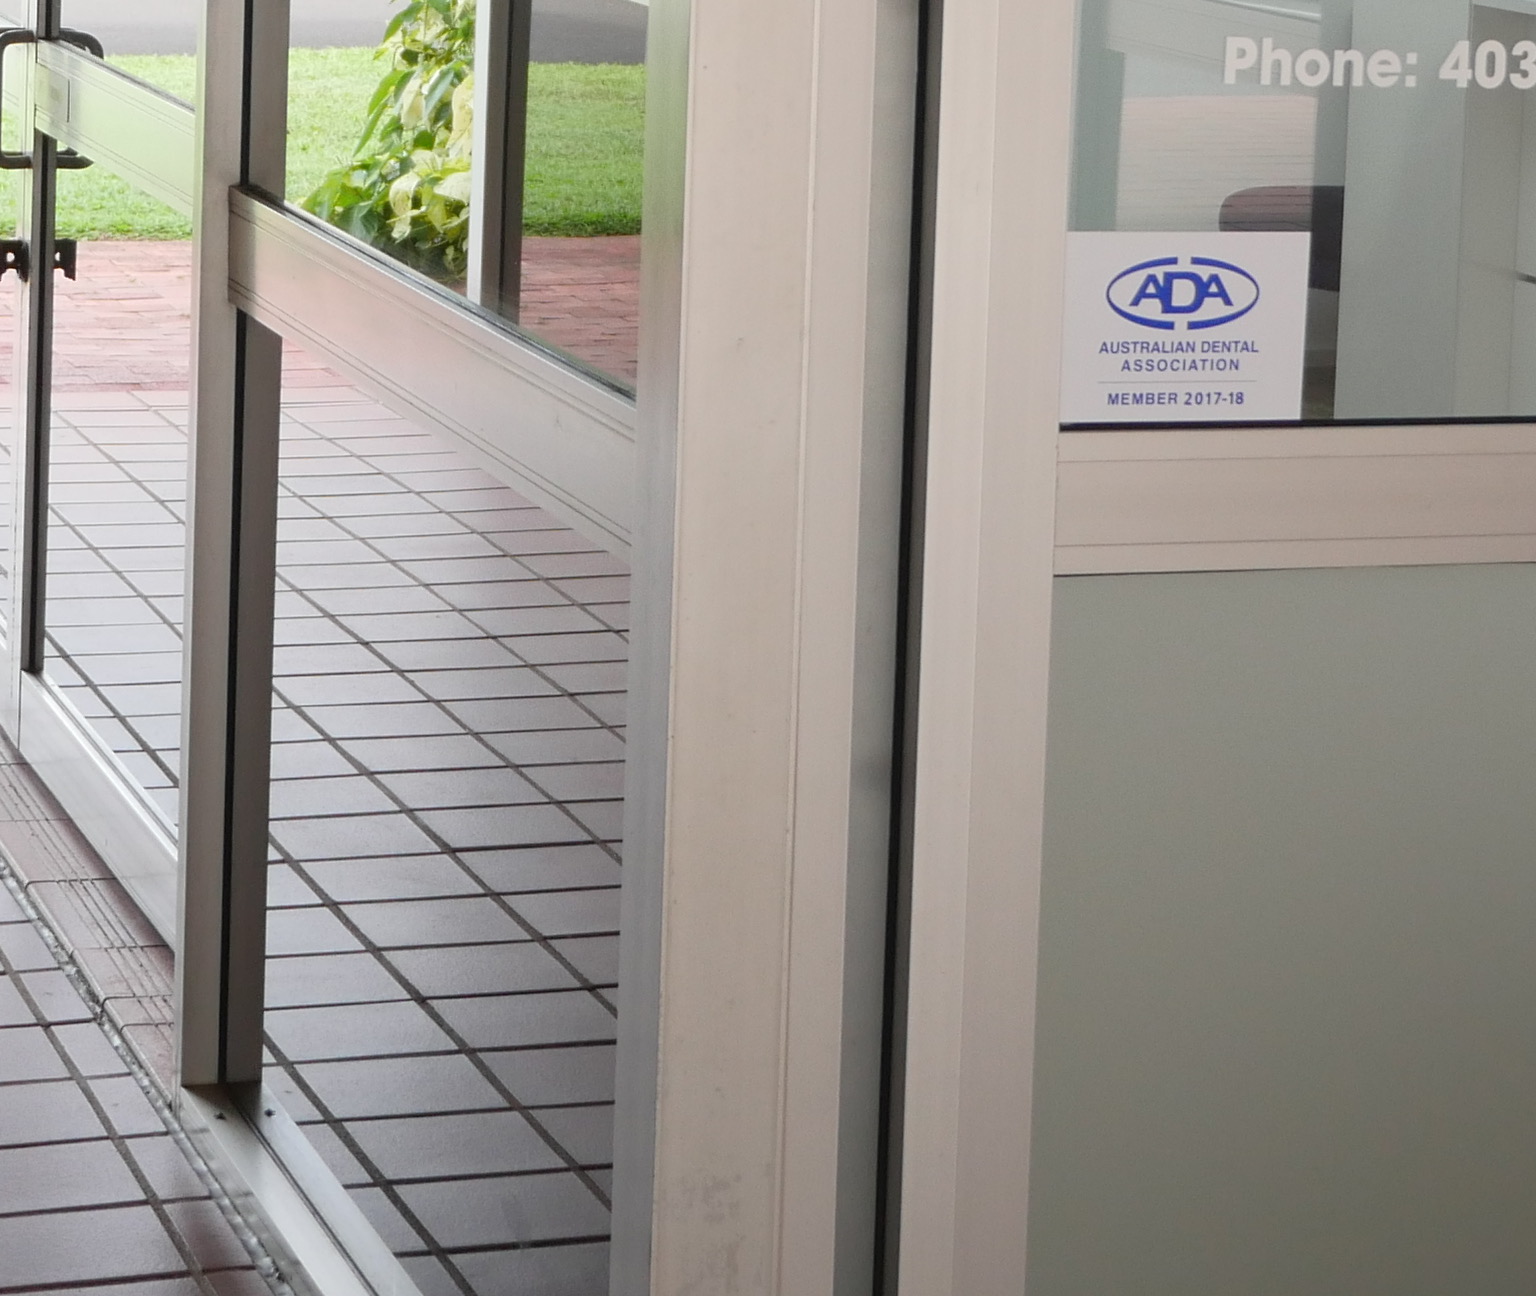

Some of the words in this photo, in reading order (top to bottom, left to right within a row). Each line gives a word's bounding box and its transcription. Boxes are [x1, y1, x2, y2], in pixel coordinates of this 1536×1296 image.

[1223, 37, 1417, 88] Phone:
[1129, 271, 1234, 314] ADA
[1098, 341, 1196, 354] AUSTRALIAN
[1200, 340, 1259, 353] DENTAL
[1121, 358, 1240, 372] ASSOCIATION
[1107, 392, 1178, 406] MEMBER
[1183, 391, 1245, 405] 2017-18
